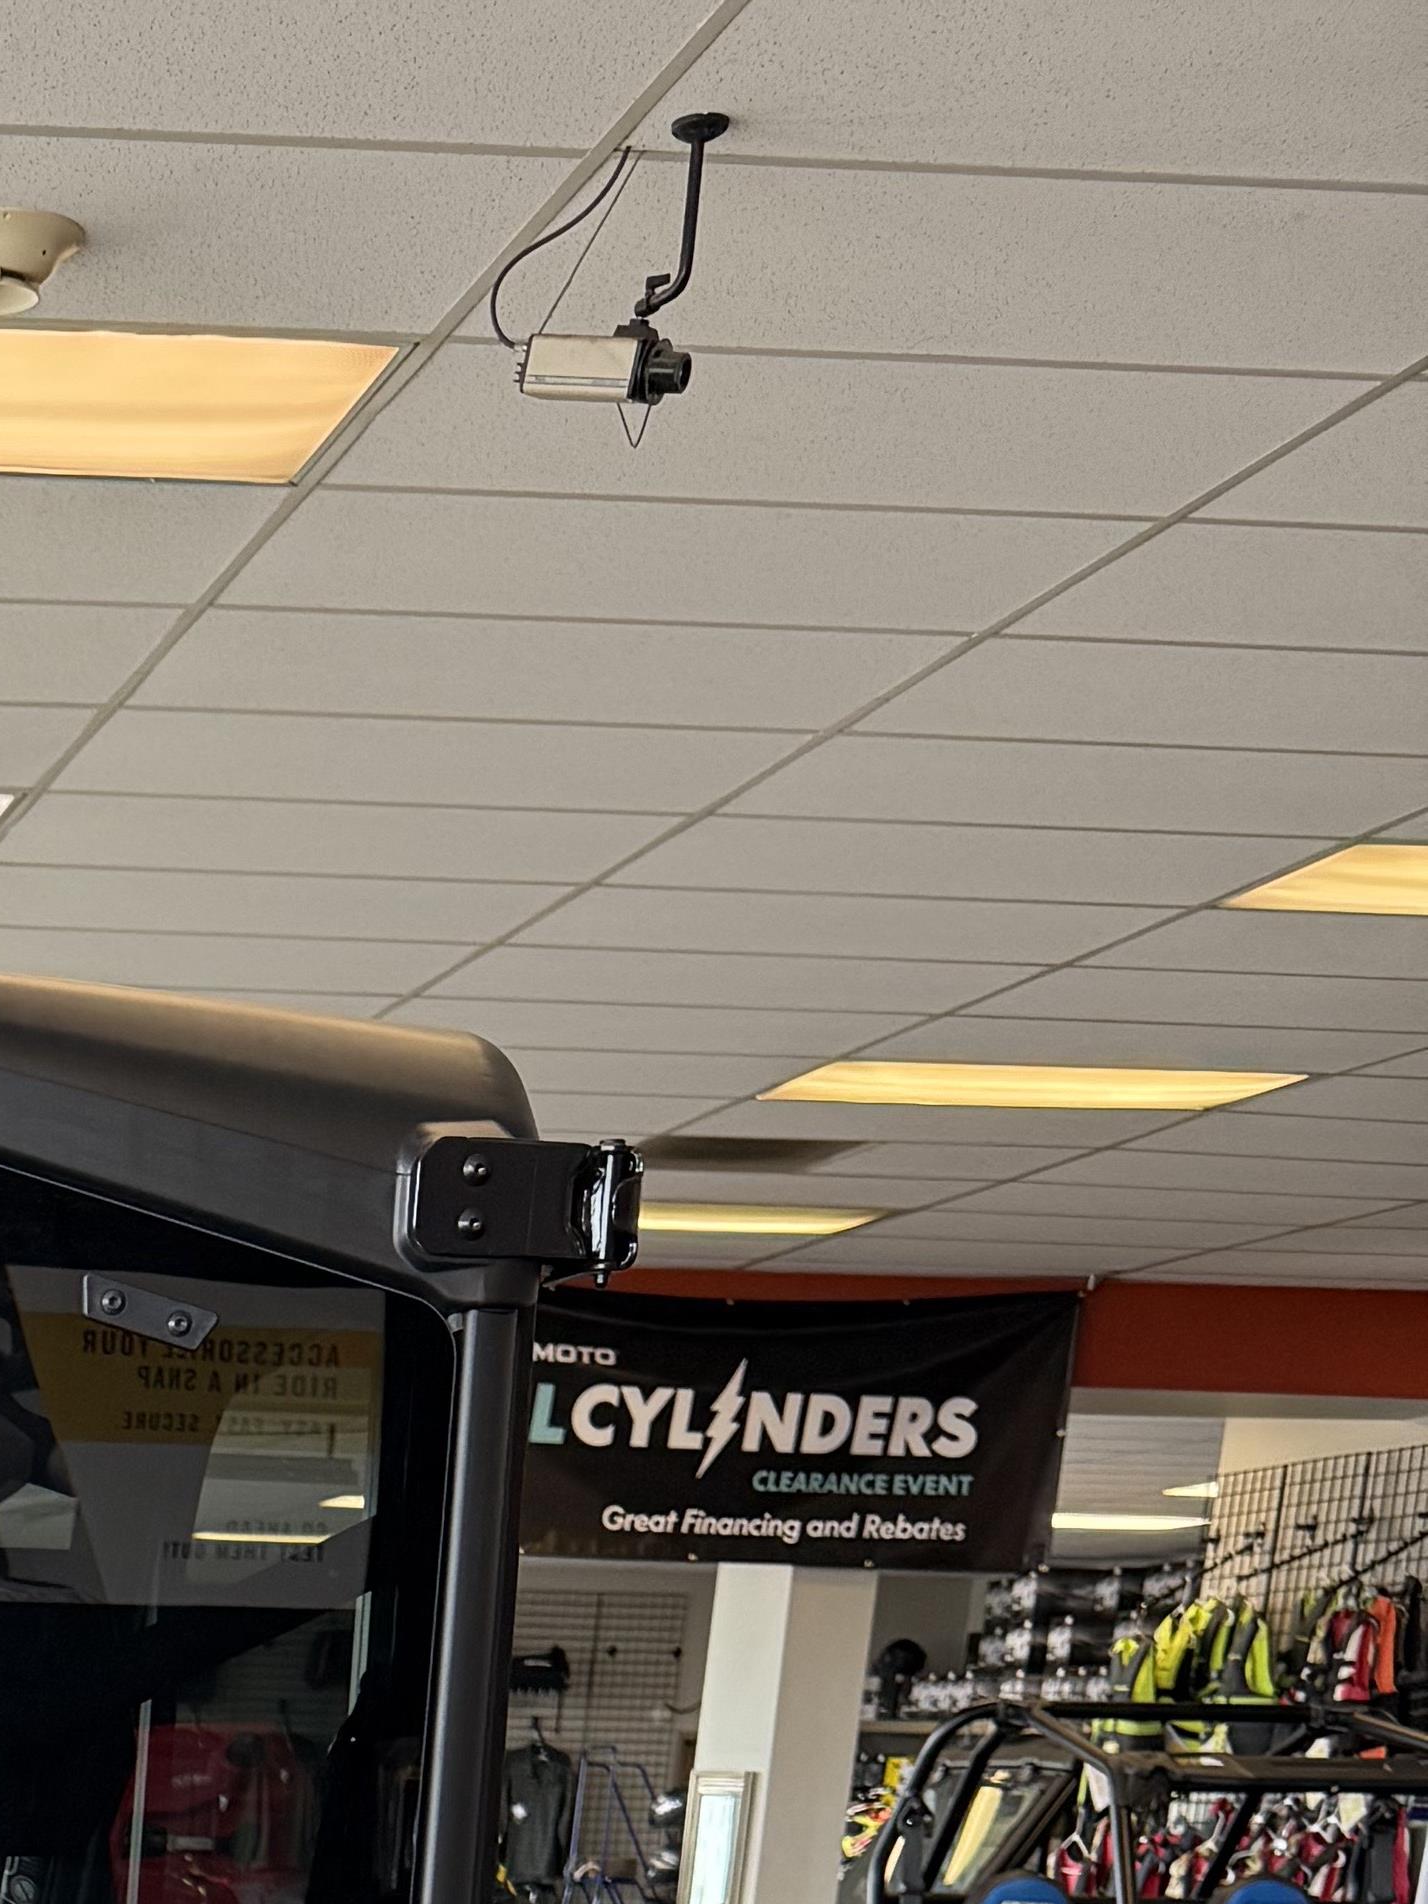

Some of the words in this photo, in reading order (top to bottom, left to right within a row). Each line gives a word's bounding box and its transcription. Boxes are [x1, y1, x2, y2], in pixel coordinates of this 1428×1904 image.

[532, 1342, 616, 1366] MOTO
[752, 1469, 889, 1496] CLEARANCE
[893, 1473, 974, 1497] EVENT
[601, 1504, 678, 1534] Great
[681, 1508, 800, 1544] Financing
[807, 1513, 856, 1541] and
[863, 1513, 966, 1543] Rebates
